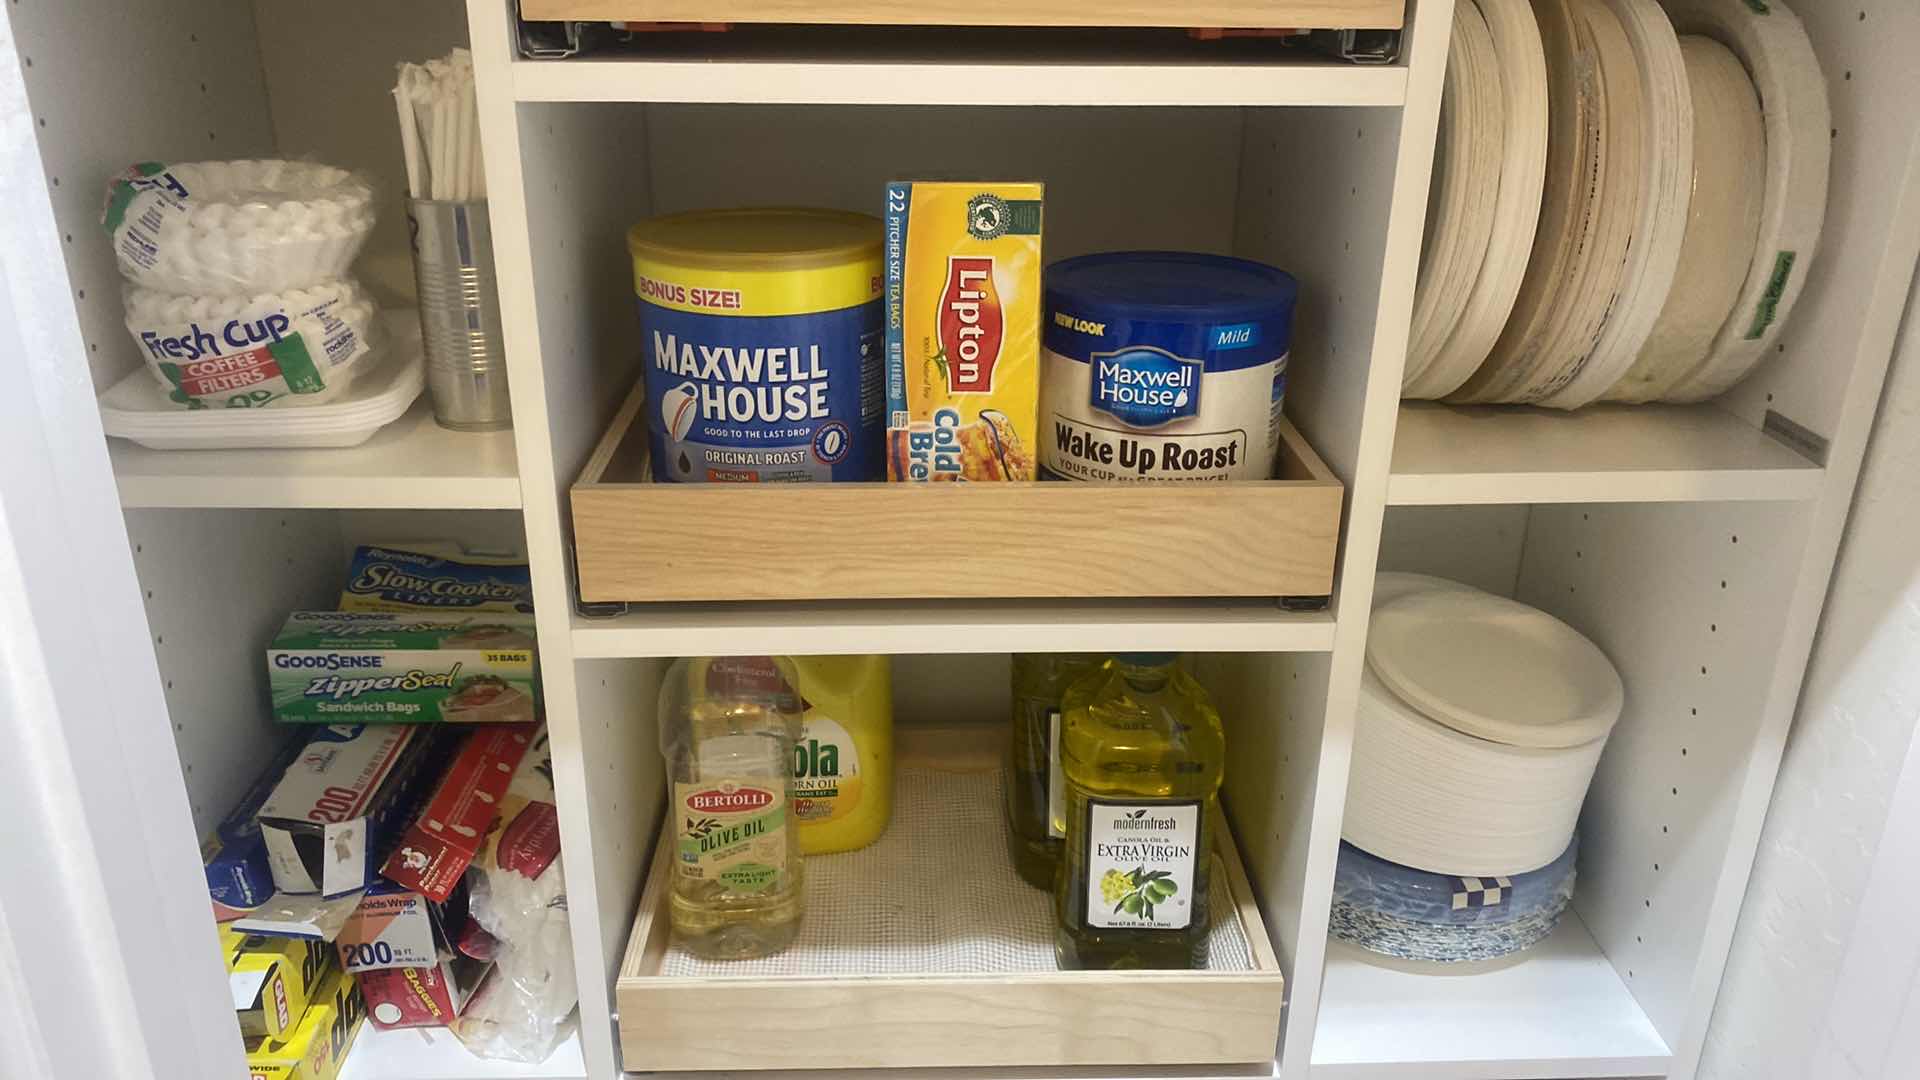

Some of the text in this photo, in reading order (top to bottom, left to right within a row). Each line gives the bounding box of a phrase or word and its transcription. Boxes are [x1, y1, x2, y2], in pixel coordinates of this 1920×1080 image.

[889, 190, 904, 329] 22 PITCHER SIZE TEA BAGS
[640, 277, 741, 309] BONUS SIZE!
[141, 324, 221, 360] Fresh
[223, 314, 289, 347] Cup
[952, 270, 987, 383] Lipton
[1074, 318, 1106, 336] LOOK
[1217, 328, 1251, 345] Mild
[187, 351, 259, 377] COFFEE
[654, 330, 828, 382] MAXWELL
[198, 368, 265, 394] FILTERS
[1099, 361, 1192, 387] Maxwell
[702, 382, 829, 422] HOUSE
[1100, 381, 1173, 406] House
[704, 427, 810, 439] GOOD TO THE LAST DROP
[934, 409, 961, 473] Cold
[705, 450, 806, 465] ORIGINAL ROAST
[910, 431, 933, 481] Bre
[1056, 422, 1237, 474] Wake Up Roast
[1060, 458, 1089, 476] YOUR
[1091, 469, 1115, 480] CUP
[354, 564, 514, 597] Slow Cooker
[275, 654, 382, 670] GOODSENSE
[304, 663, 462, 699] ZipperSeal
[317, 701, 420, 715] Sandwich Bags
[794, 739, 838, 777] ola
[818, 780, 838, 789] OIL
[308, 787, 359, 823] 200
[694, 794, 765, 808] BERTOLLI
[701, 828, 739, 852] OLIVE
[744, 819, 765, 837] OIL
[1113, 817, 1176, 830] modernfresh
[1098, 844, 1189, 857] EXTRA VIRGIN
[721, 871, 750, 879] EXTRA
[387, 898, 417, 908] Wrap
[343, 941, 392, 967] 200
[274, 978, 288, 1030] GLAD
[403, 968, 442, 1017] BAGGIES
